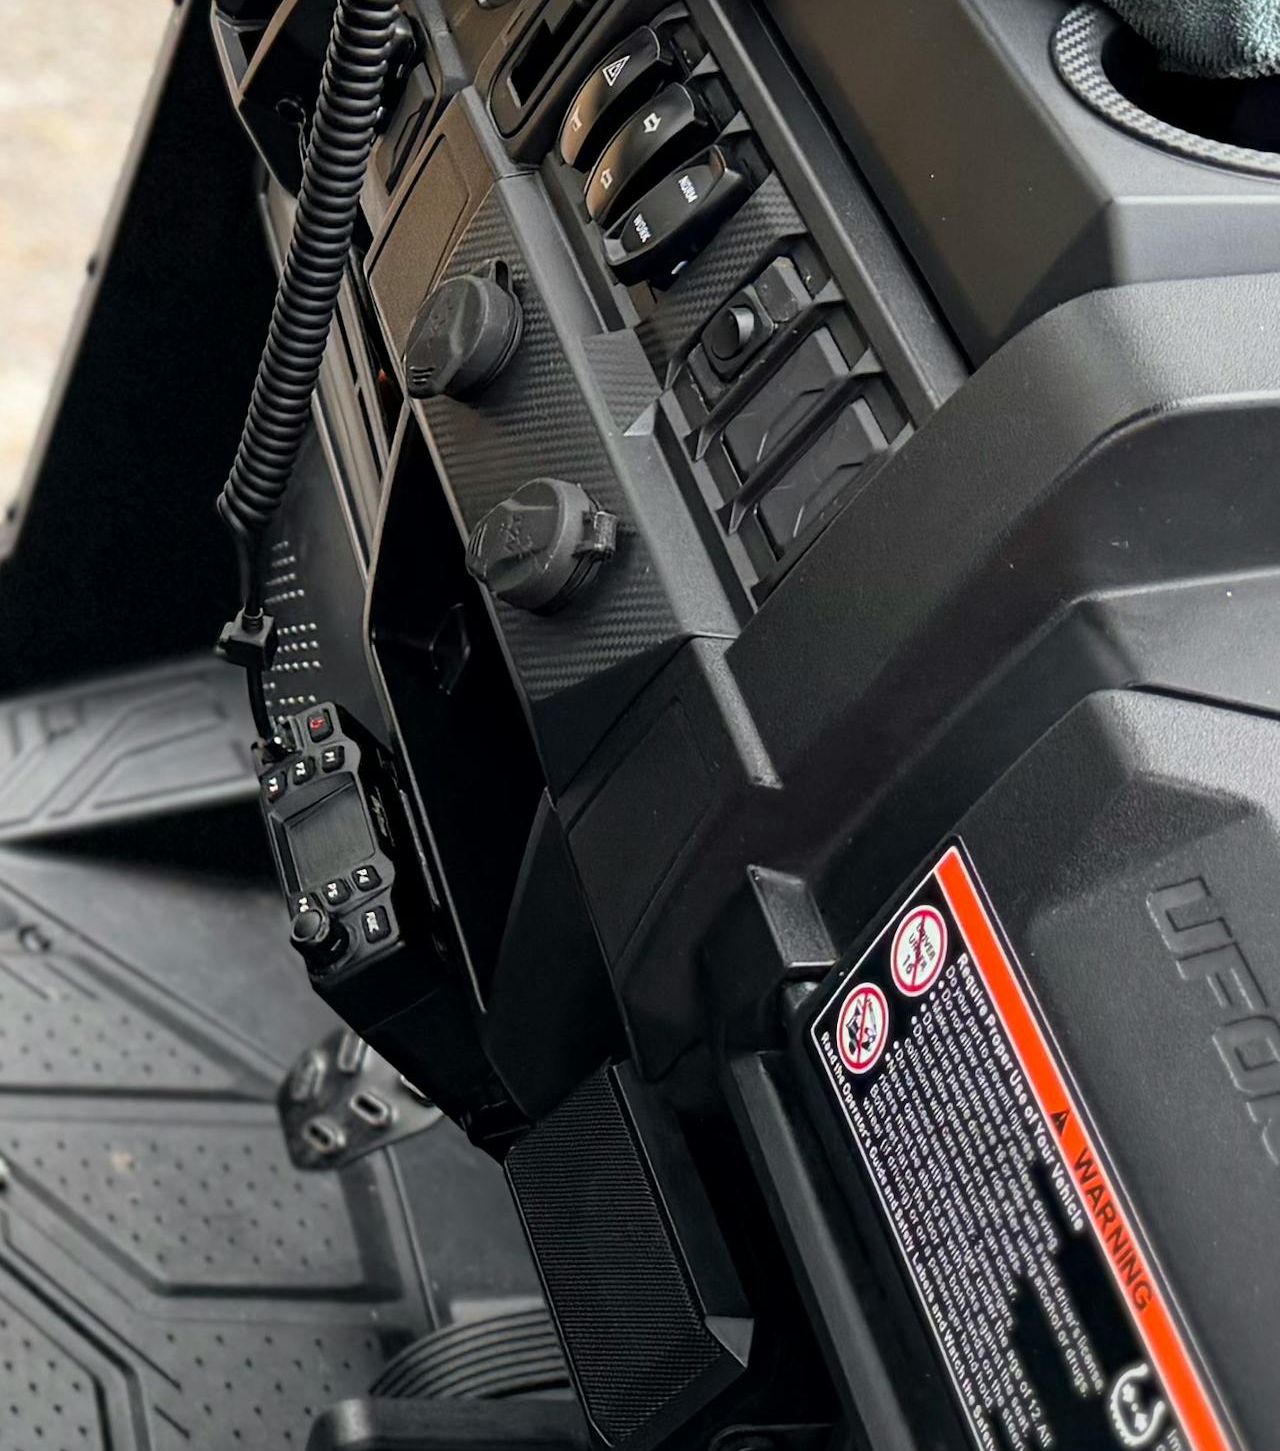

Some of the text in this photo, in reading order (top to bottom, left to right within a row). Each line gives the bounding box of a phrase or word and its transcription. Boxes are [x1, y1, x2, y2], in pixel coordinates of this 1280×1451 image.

[633, 212, 652, 243] WORK
[295, 761, 306, 776] P2
[356, 868, 371, 884] P4
[902, 954, 914, 975] 16
[908, 932, 928, 972] UNER
[922, 1011, 934, 1034] Do
[930, 1033, 945, 1057] not
[945, 964, 958, 988] Do
[952, 986, 971, 1016] your
[965, 1015, 984, 1045] part
[978, 1041, 989, 1059] to
[984, 1057, 1014, 1111] prevent
[940, 1052, 953, 1075] let
[940, 987, 953, 1011] Do
[949, 1009, 964, 1034] not
[959, 1032, 979, 1067] allow
[974, 1067, 1003, 1125] careless
[999, 1124, 1011, 1140] or
[1006, 1140, 1036, 1200] reckless
[946, 1073, 971, 1120] people
[956, 952, 1084, 1231] Require Proper Use of Your Vehicle
[894, 1048, 906, 1070] Do
[903, 1068, 916, 1091] not
[911, 1089, 935, 1135] exceed
[930, 1133, 953, 1183] seating
[912, 1023, 925, 1046] Do
[920, 1044, 935, 1069] not
[930, 1066, 949, 1103] allow
[945, 1102, 976, 1167] operation
[972, 1166, 985, 1187] on
[979, 1185, 1003, 1230] public
[967, 1119, 986, 1155] drive
[904, 1037, 933, 1099] collisions
[929, 1096, 945, 1127] with
[941, 1126, 958, 1158] cars
[954, 1156, 971, 1185] and
[965, 1181, 988, 1228] trucks
[984, 1227, 999, 1256] can
[931, 999, 949, 1037] Make
[945, 1034, 962, 1064] sure
[957, 1062, 987, 1124] operators
[983, 1121, 997, 1146] are
[994, 1143, 1007, 1164] 16
[1001, 1163, 1012, 1178] or
[1007, 1178, 1027, 1213] older
[1023, 1212, 1039, 1243] with
[1040, 1252, 1061, 1288] valid
[1054, 1286, 1081, 1339] driver's
[982, 1154, 994, 1170] or
[989, 1170, 1006, 1200] ride
[820, 1031, 838, 1066] Read
[833, 1062, 846, 1086] the
[842, 1082, 872, 1149] Operator's
[869, 1145, 888, 1186] Guide
[884, 1185, 900, 1211] and
[894, 1208, 915, 1253] Safety
[911, 1251, 935, 1303] Labels
[931, 1303, 948, 1333] and
[943, 1328, 965, 1380] Watch
[962, 1378, 976, 1406] the
[862, 1096, 884, 1139] wheel
[887, 1155, 913, 1210] driving)
[909, 1208, 919, 1225] or
[915, 1225, 927, 1246] on
[927, 1256, 963, 1332] passenger
[960, 1331, 980, 1373] hand
[878, 1073, 898, 1115] riders
[894, 1113, 914, 1150] must
[909, 1145, 922, 1169] be
[917, 1168, 934, 1201] able
[931, 1199, 941, 1217] to
[937, 1216, 950, 1238] sit
[946, 1235, 962, 1270] with
[958, 1265, 980, 1312] backs
[976, 1313, 1004, 1370] against
[1000, 1367, 1014, 1396] the
[1001, 1199, 1021, 1233] after
[1074, 1146, 1152, 1311] WARNING
[869, 1083, 887, 1119] Both
[883, 1115, 899, 1146] feet
[894, 1143, 909, 1171] flat
[904, 1168, 916, 1189] on
[912, 1186, 925, 1213] the
[922, 1209, 940, 1245] floor
[936, 1246, 953, 1276] and
[948, 1273, 966, 1311] both
[962, 1308, 985, 1359] hands
[982, 1358, 994, 1381] on
[990, 1378, 1005, 1407] the
[886, 1058, 908, 1102] Never
[903, 1102, 930, 1156] operate
[926, 1155, 943, 1188] with
[942, 1198, 980, 1274] passenger
[975, 1275, 999, 1320] under
[994, 1319, 1009, 1348] the
[1006, 1349, 1023, 1380] age
[1019, 1381, 1033, 1399] of
[1036, 1424, 1052, 1448] All
[1016, 1233, 1038, 1278] using
[1033, 1275, 1064, 1330] alcohol
[1057, 1329, 1070, 1347] or
